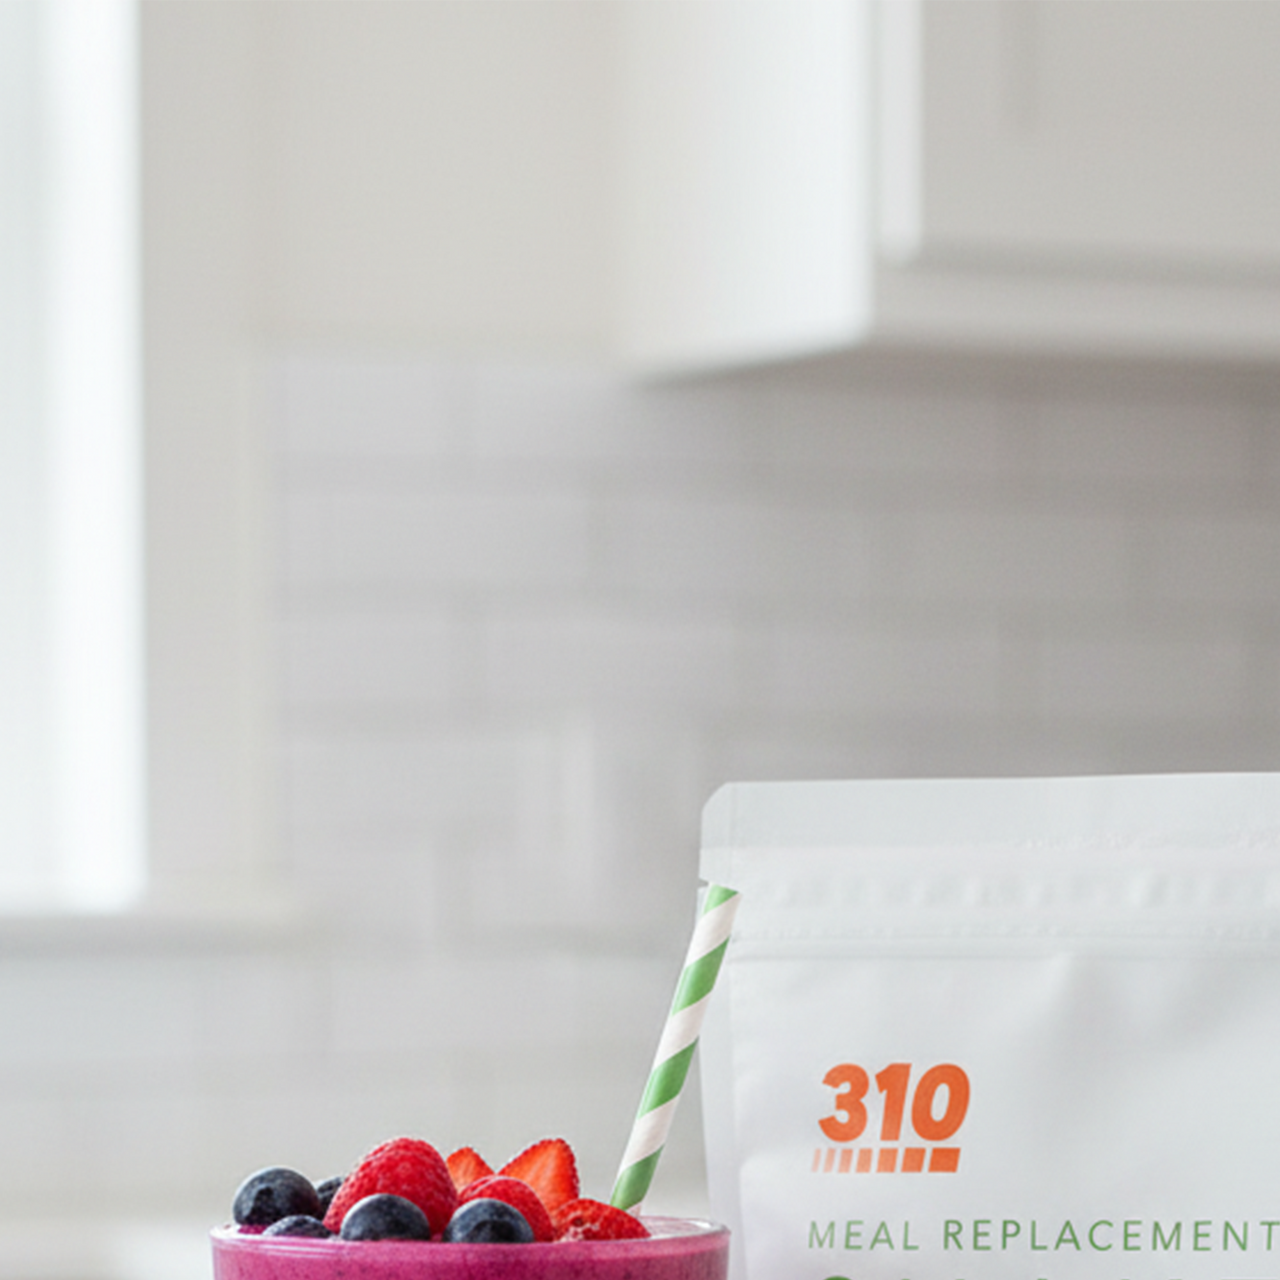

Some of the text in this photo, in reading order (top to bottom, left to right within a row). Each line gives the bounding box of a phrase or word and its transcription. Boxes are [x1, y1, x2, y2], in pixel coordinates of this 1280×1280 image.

[818, 1063, 971, 1143] 310
[808, 1220, 1280, 1252] MEAL REPLACEMENT
